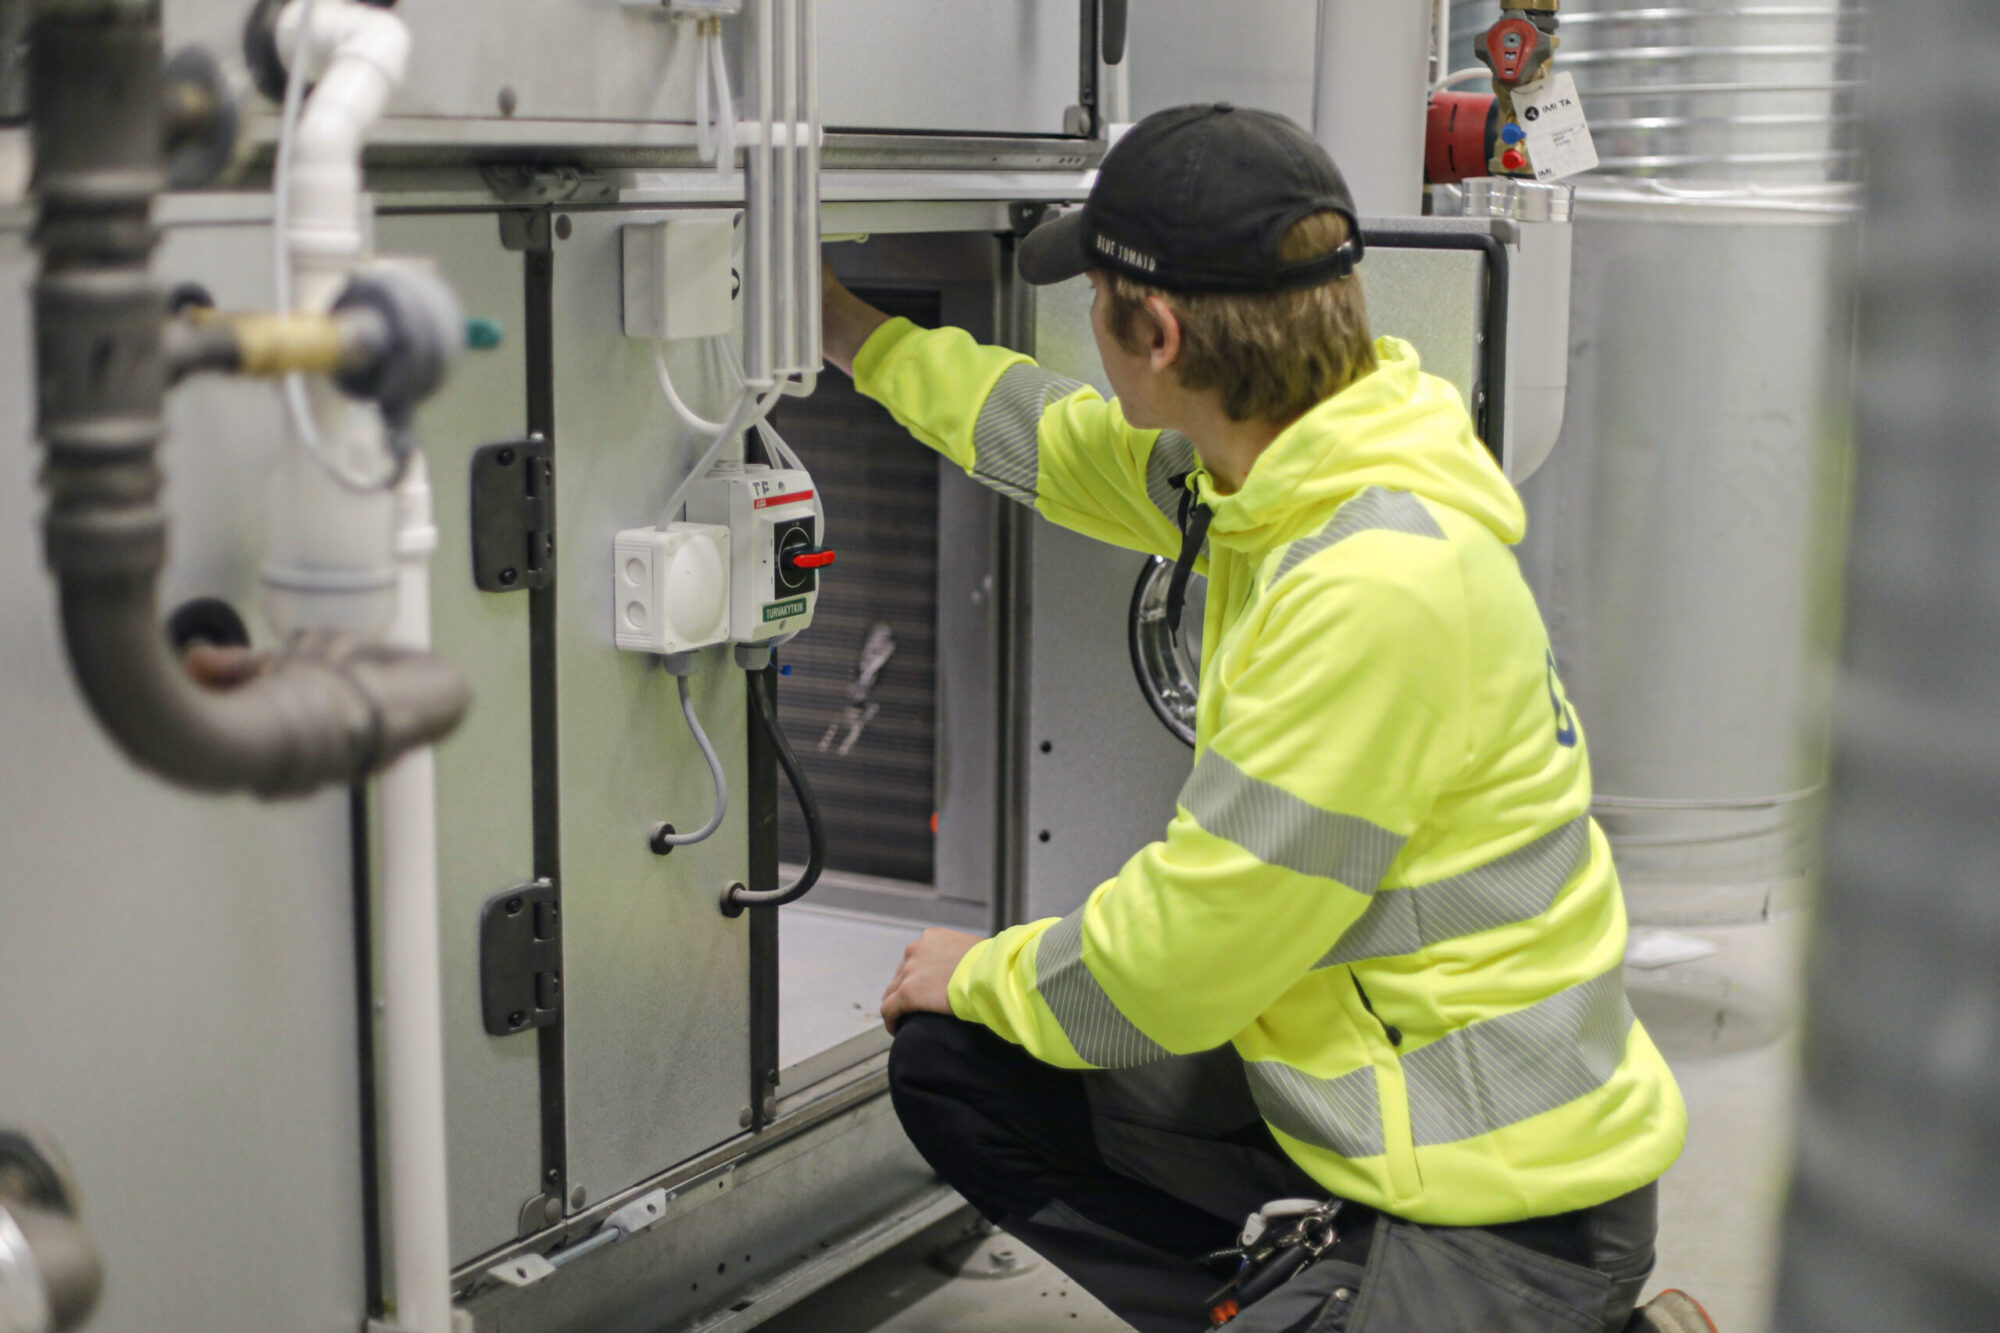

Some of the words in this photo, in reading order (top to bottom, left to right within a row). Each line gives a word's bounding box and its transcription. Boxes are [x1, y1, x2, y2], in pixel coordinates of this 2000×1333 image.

[1542, 103, 1557, 113] IMI
[1559, 99, 1572, 108] TA
[1538, 168, 1552, 177] IMI
[1097, 234, 1115, 256] BLUE
[1118, 245, 1156, 272] TOMATO
[766, 602, 803, 619] TURVAKYTKIN
